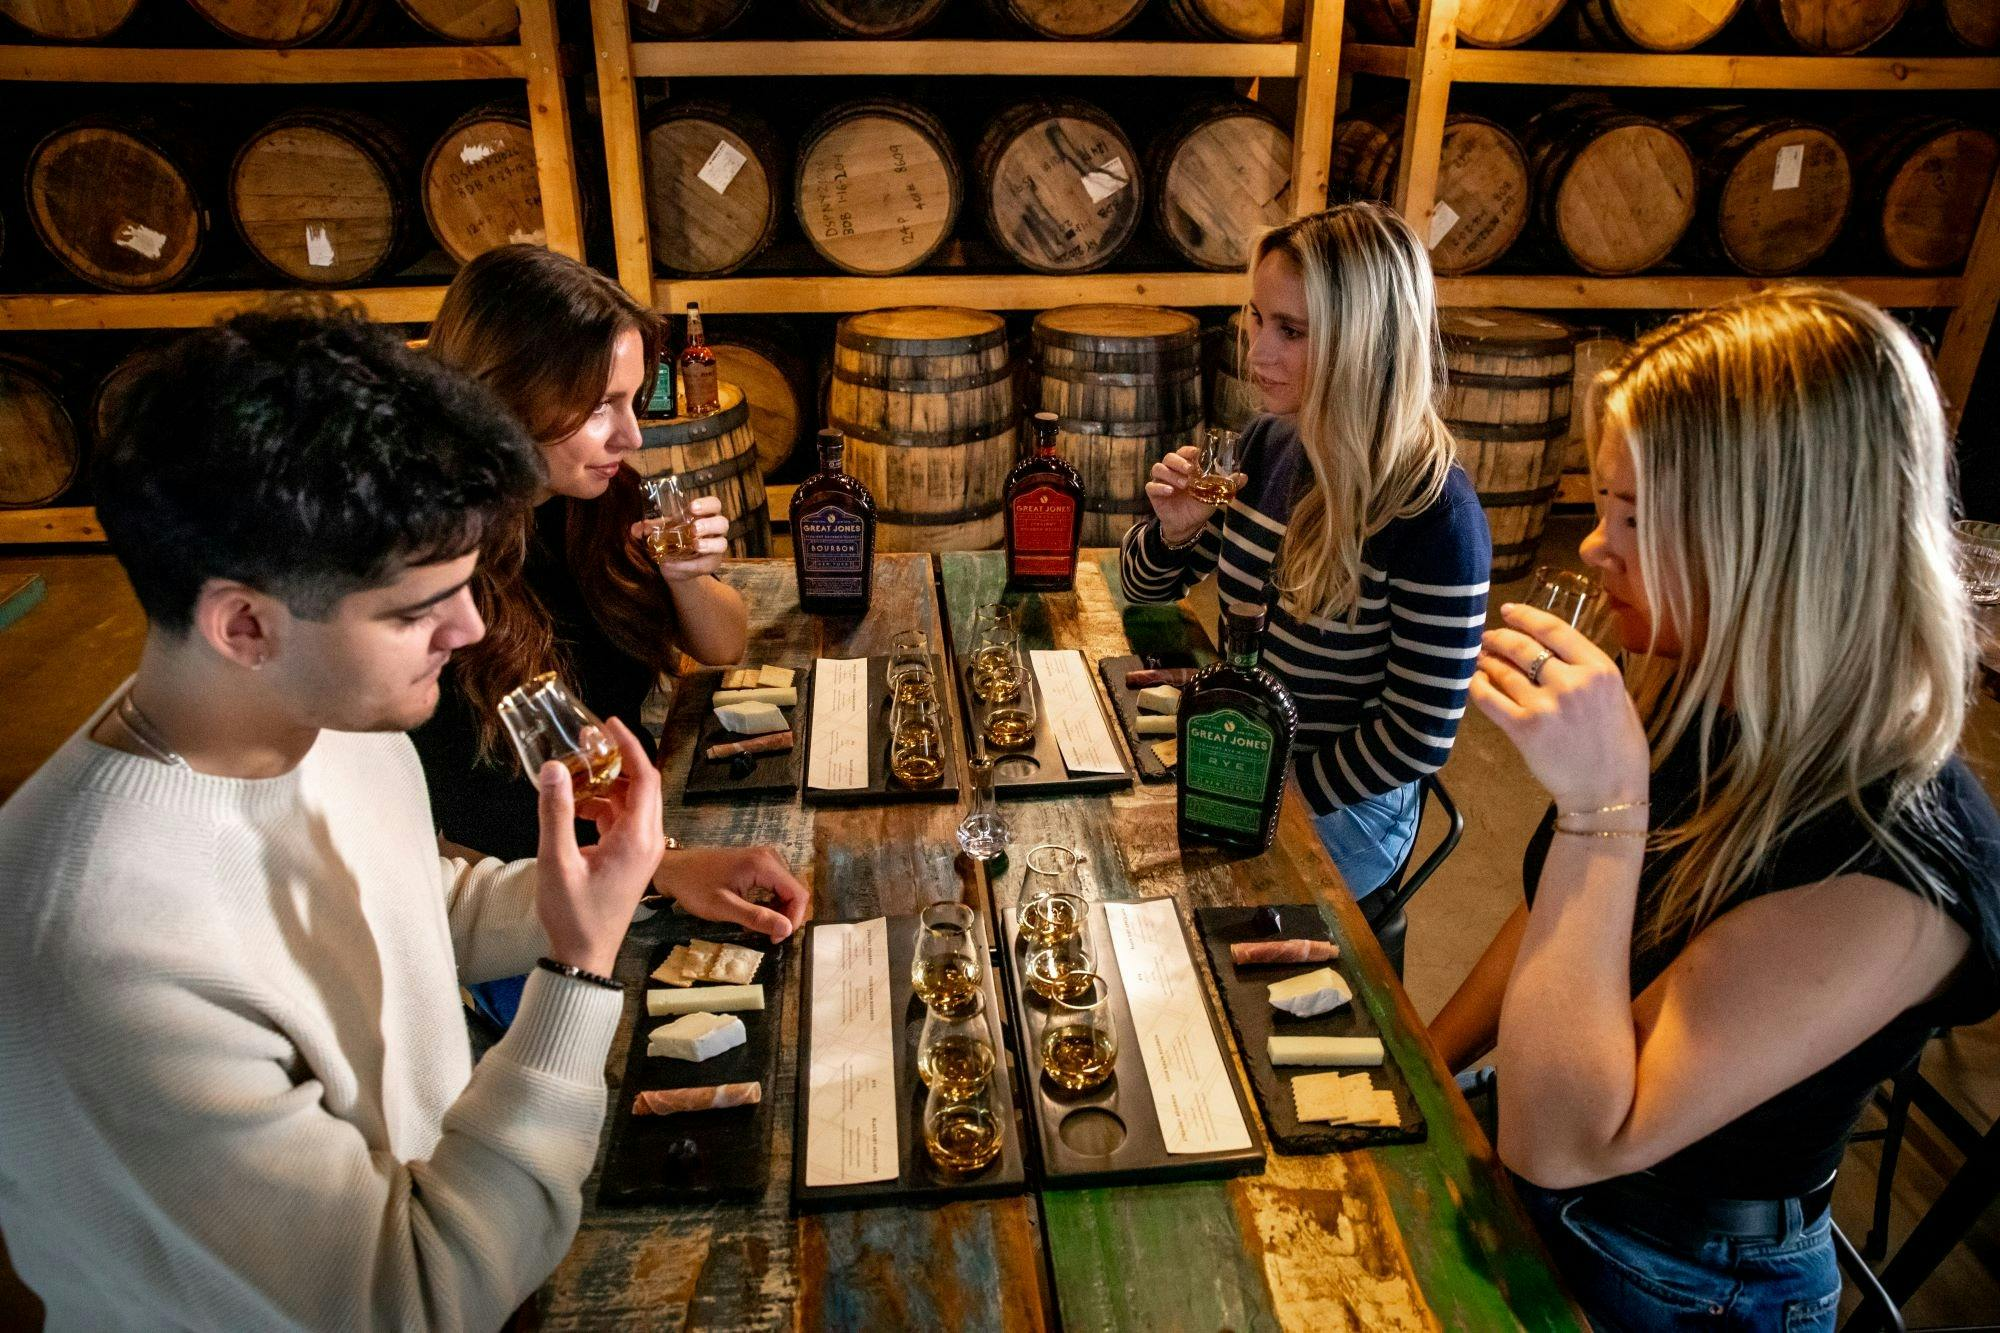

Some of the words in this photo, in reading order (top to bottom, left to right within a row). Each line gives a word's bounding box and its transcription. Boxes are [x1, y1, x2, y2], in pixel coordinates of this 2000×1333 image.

[1016, 505, 1043, 513] GREAT
[803, 525, 831, 533] GREAT
[833, 525, 861, 533] JONES
[1191, 728, 1228, 743] GREAT
[1231, 736, 1268, 751] JONES
